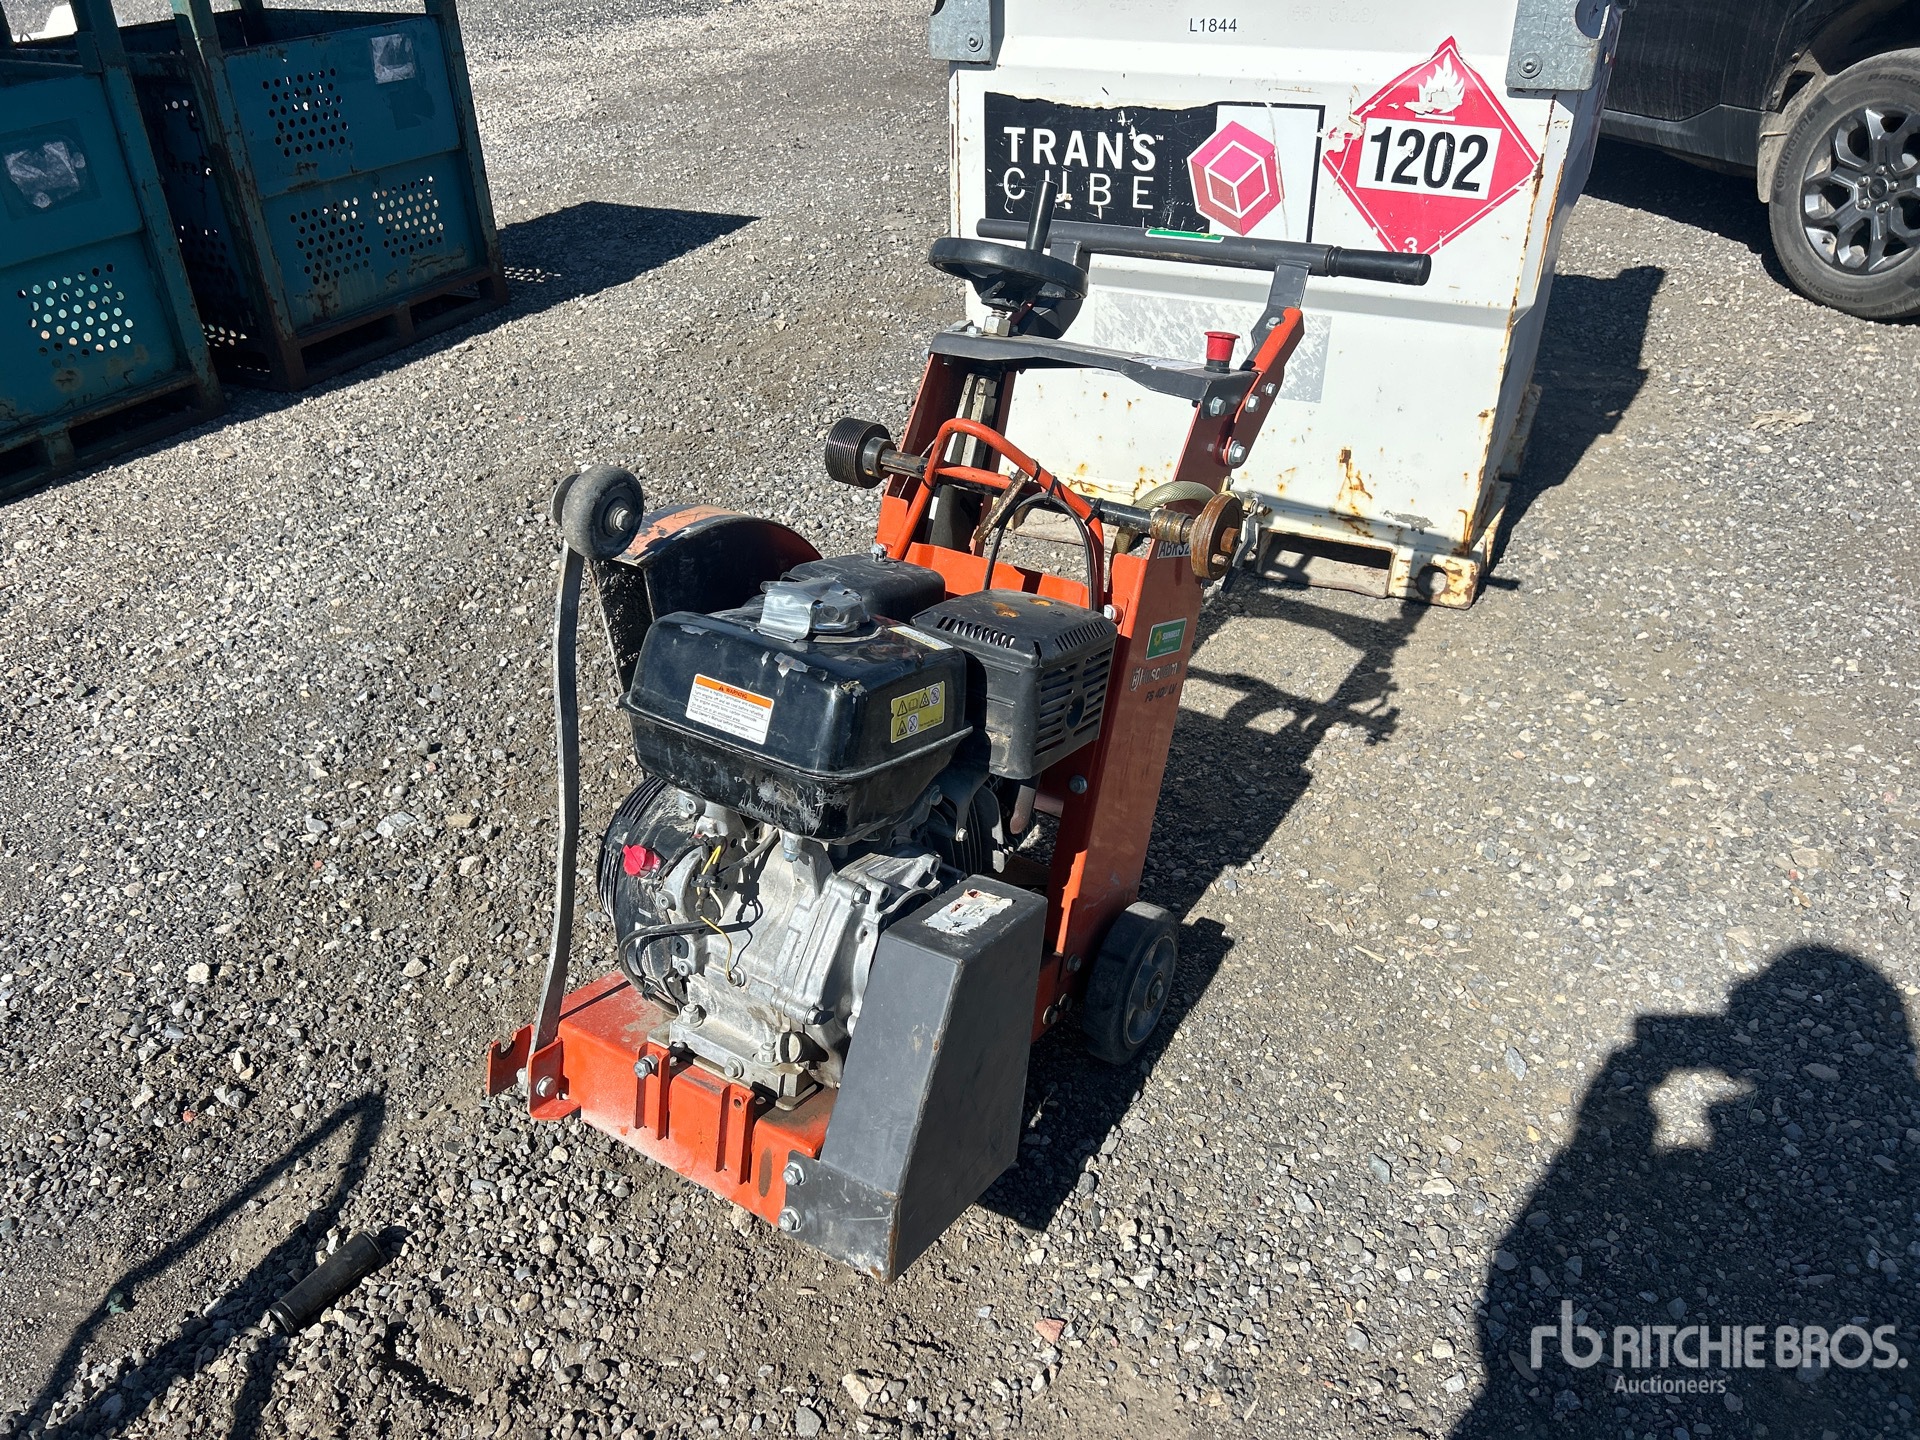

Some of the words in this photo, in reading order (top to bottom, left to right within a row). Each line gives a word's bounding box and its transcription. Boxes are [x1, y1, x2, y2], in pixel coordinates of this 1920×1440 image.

[1189, 17, 1238, 33] L1844
[1370, 125, 1489, 192] 1202
[1402, 236, 1419, 254] 3
[725, 687, 747, 698] WARNING
